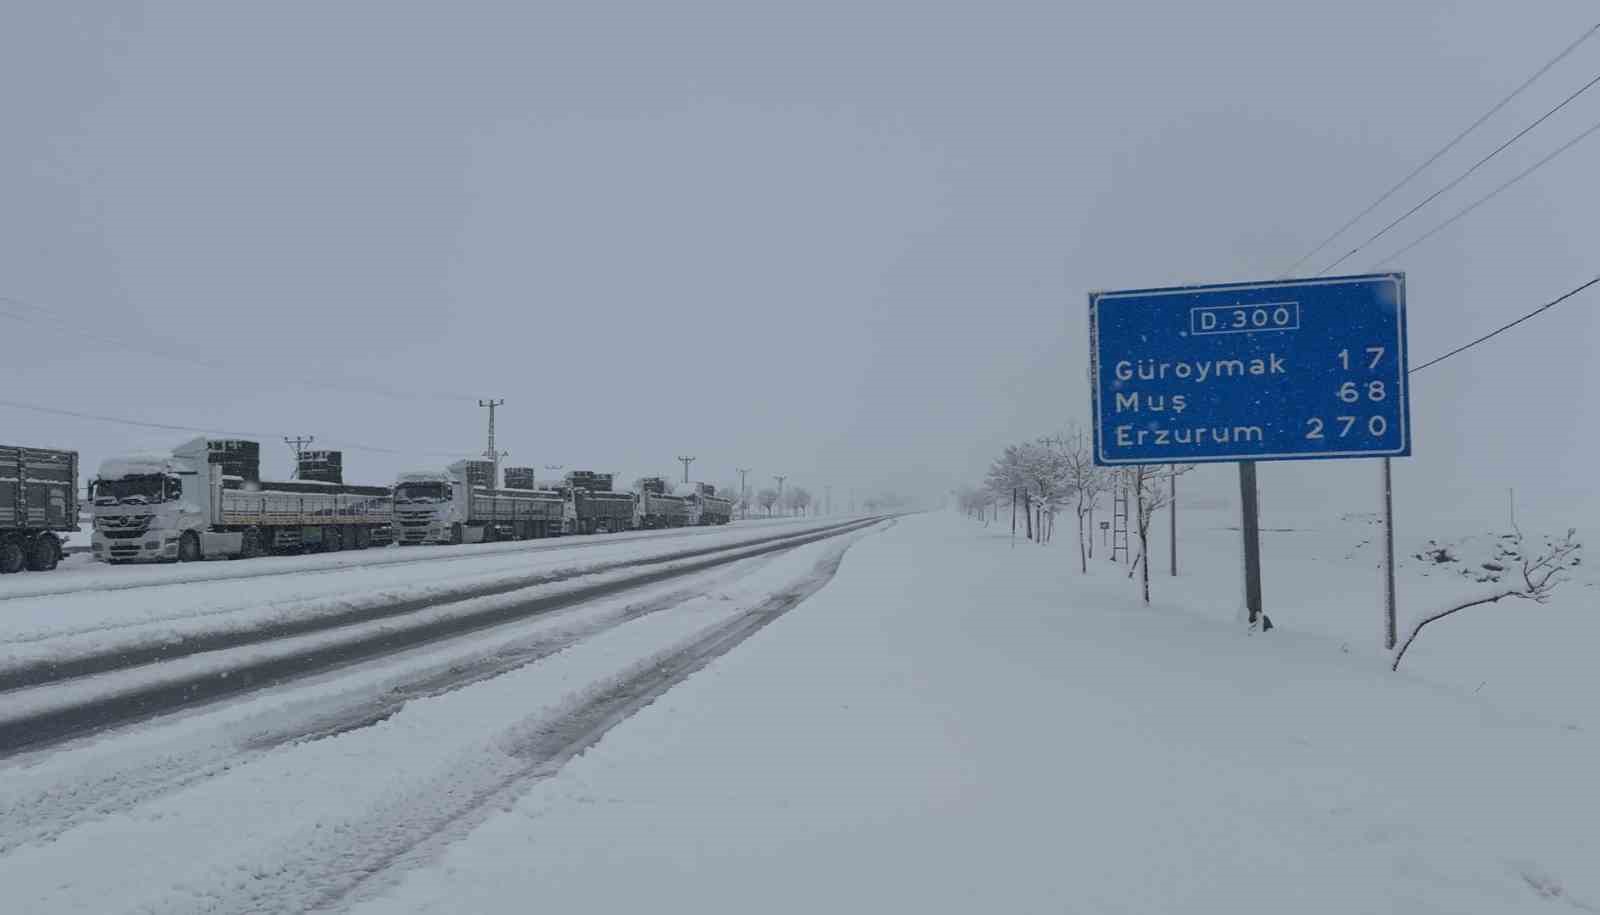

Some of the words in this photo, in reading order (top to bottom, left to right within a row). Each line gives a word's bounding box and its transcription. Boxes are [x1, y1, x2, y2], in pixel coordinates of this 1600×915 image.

[1115, 352, 1286, 382] Güroymak
[1337, 347, 1385, 370] 17
[1115, 391, 1187, 413] Muş
[1340, 381, 1386, 403] 68
[1116, 424, 1263, 446] Erzurum
[1305, 416, 1387, 439] 270
